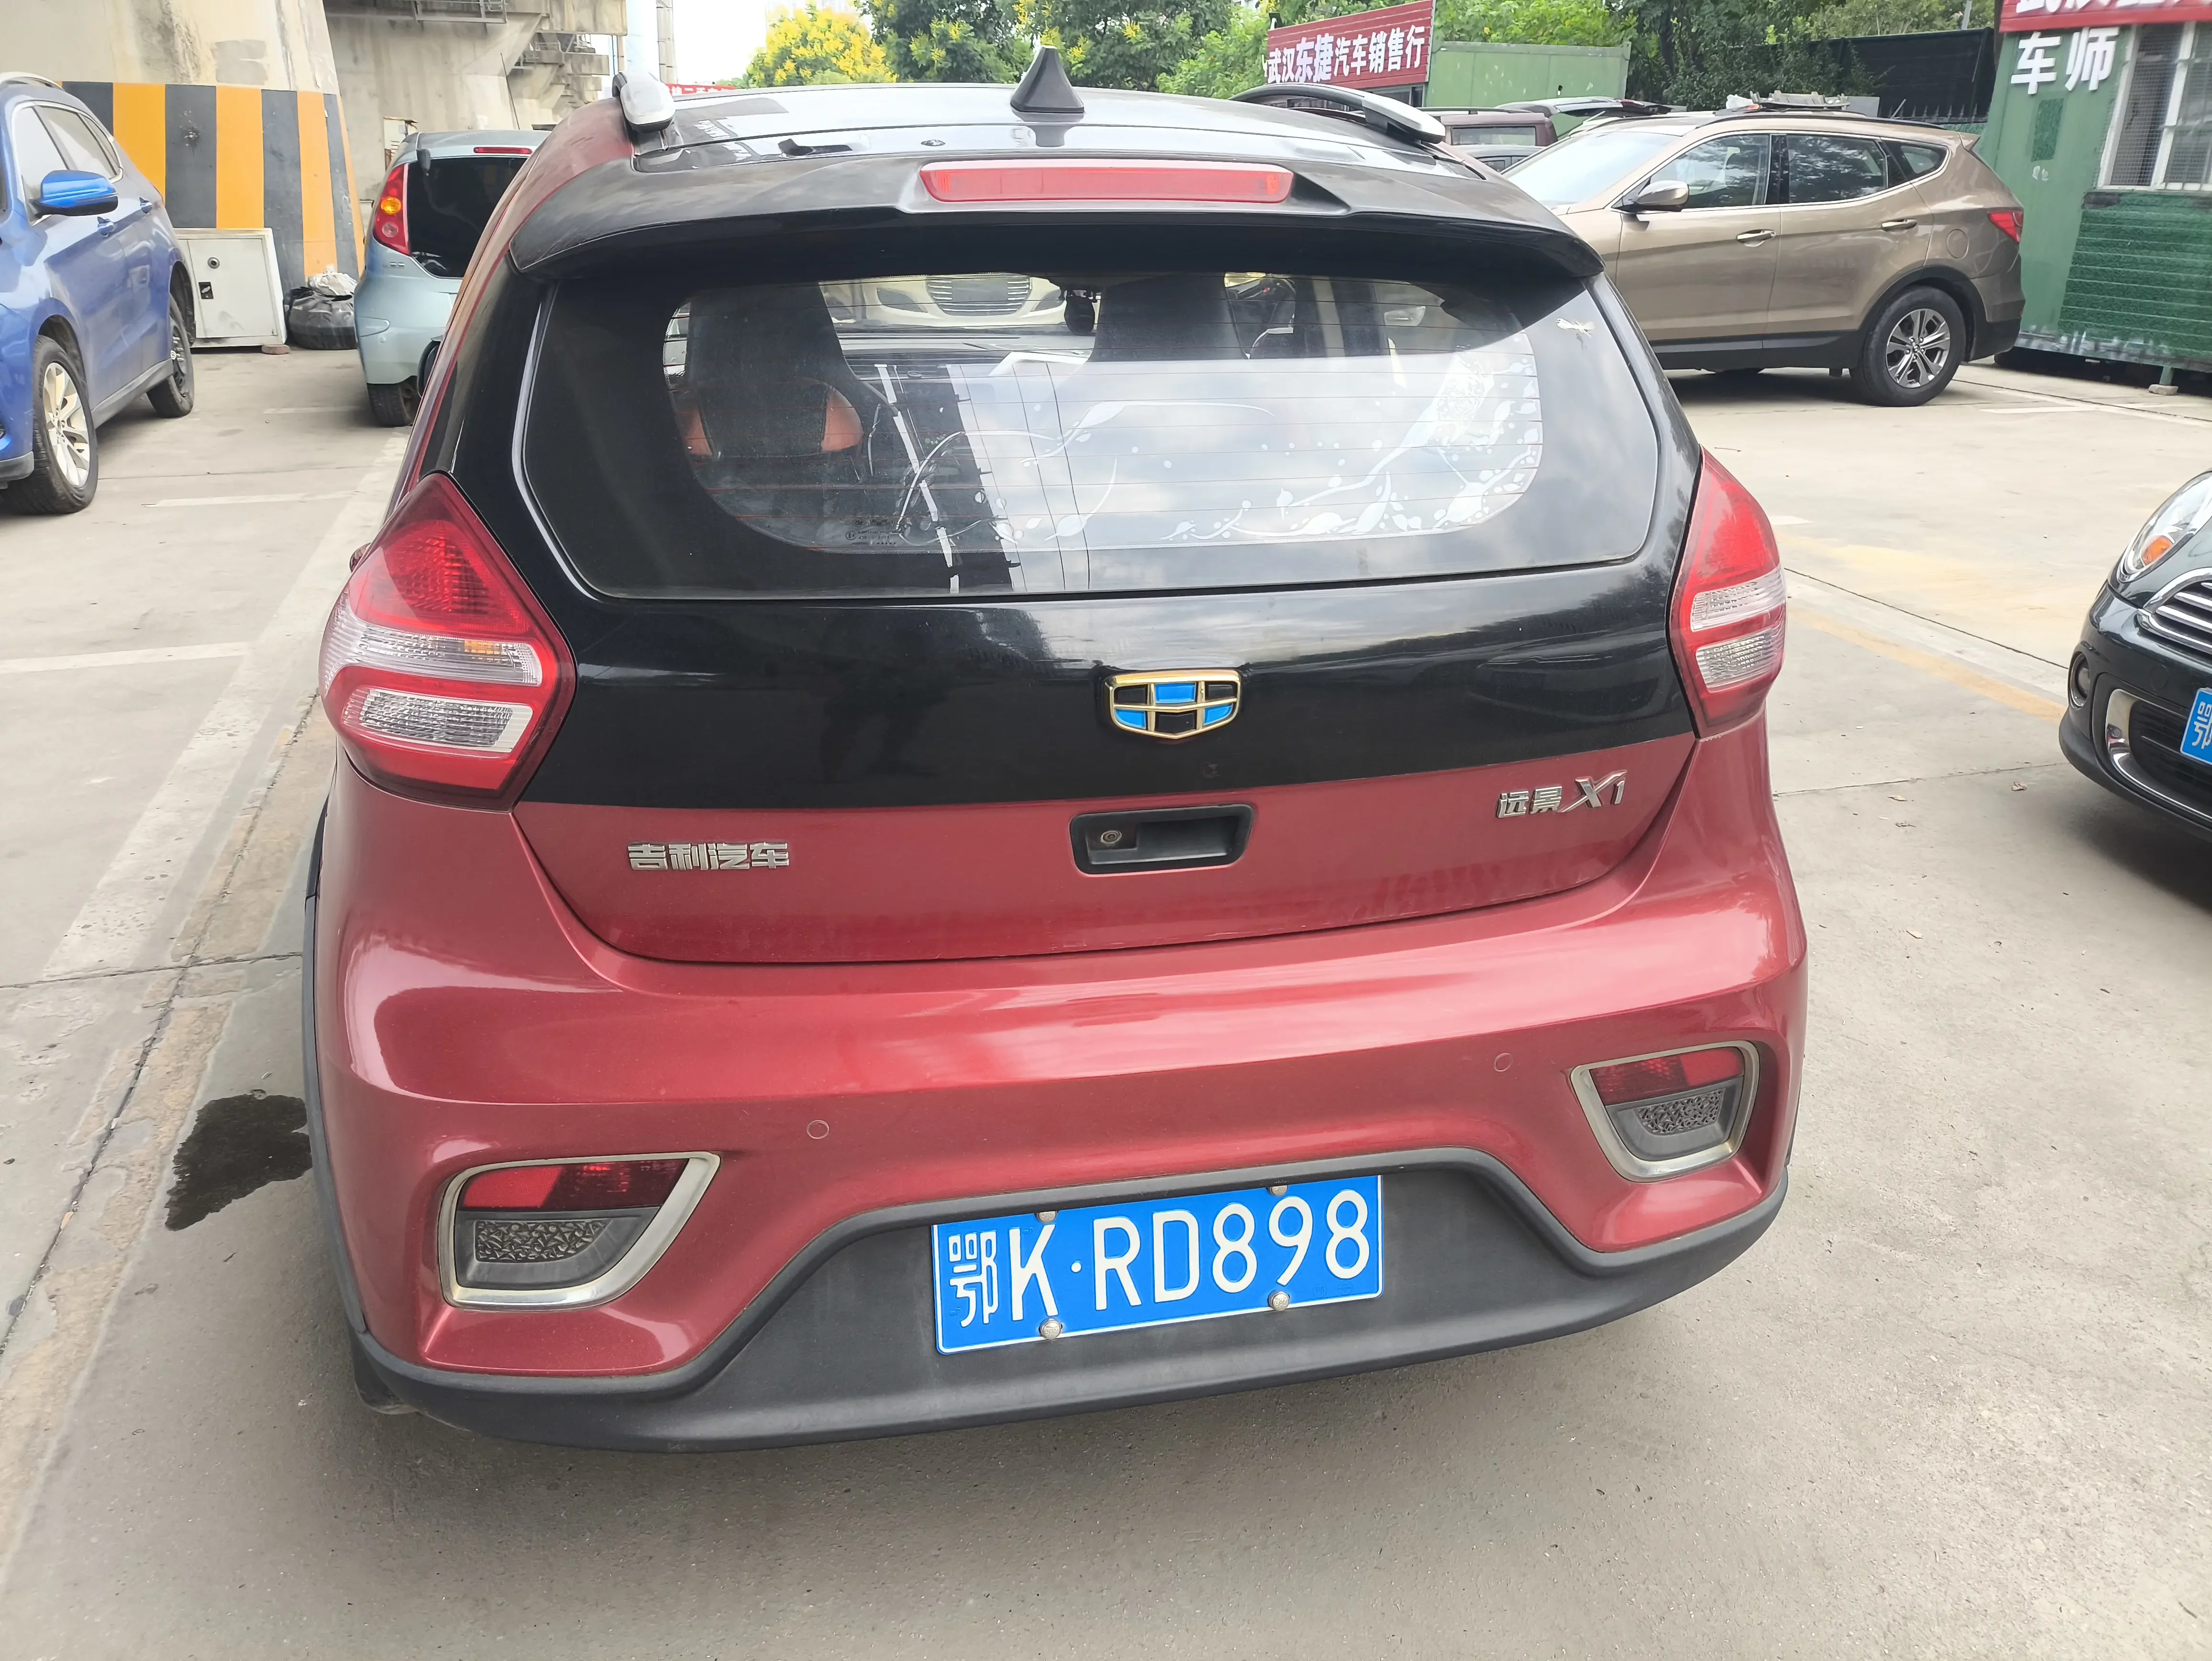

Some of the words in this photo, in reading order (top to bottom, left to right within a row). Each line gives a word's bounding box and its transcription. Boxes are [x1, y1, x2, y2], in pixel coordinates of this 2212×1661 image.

[1267, 24, 1425, 83] 武汉东捷汽车销售行
[2011, 27, 2119, 95] 车师
[627, 842, 790, 871] 吉利汽车
